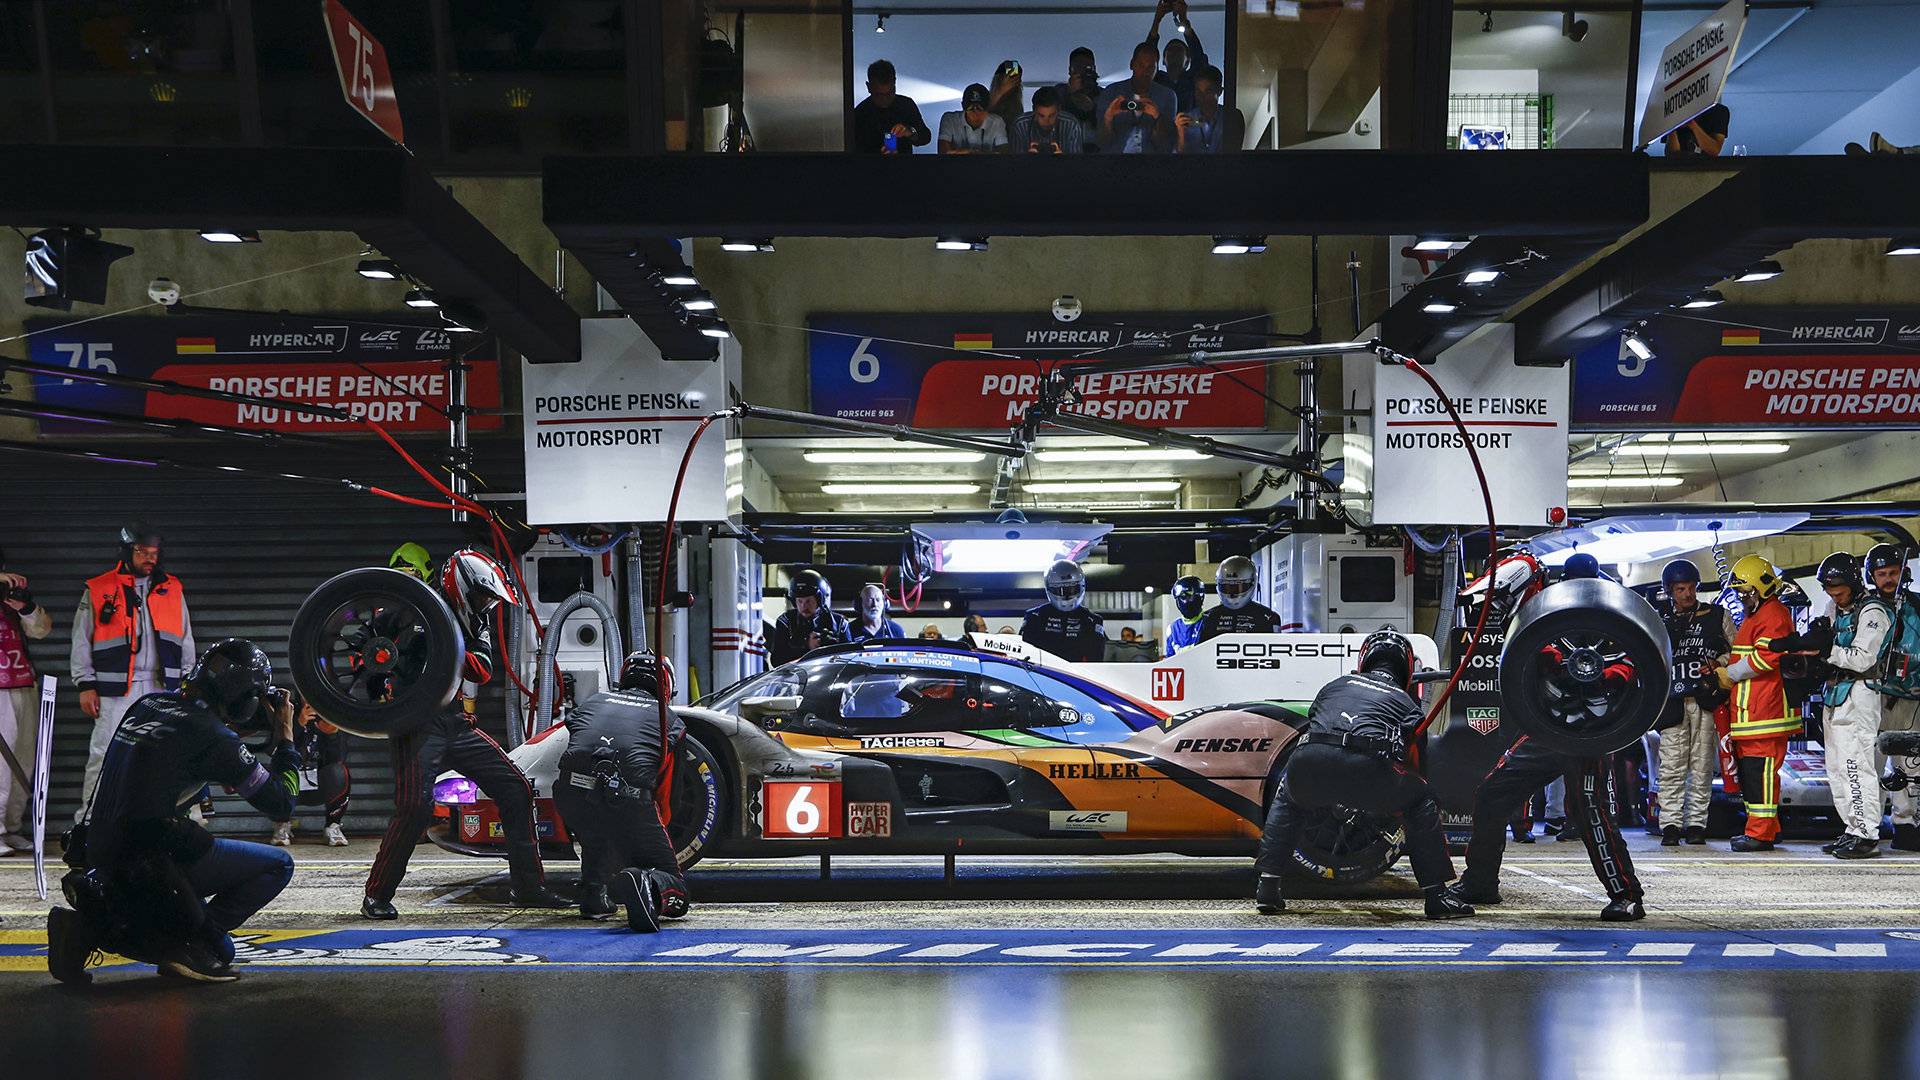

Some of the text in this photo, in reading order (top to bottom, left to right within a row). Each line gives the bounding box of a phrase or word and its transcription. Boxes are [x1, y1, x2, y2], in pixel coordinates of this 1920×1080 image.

[1664, 23, 1724, 80] PORSCHE PENSKE
[348, 22, 375, 112] 75
[1663, 73, 1710, 118] MOTORSPORT
[249, 333, 335, 347] HYPERCAR
[1025, 330, 1110, 344] HYPERCAR
[1791, 326, 1876, 340] HYPERCAR
[848, 337, 881, 383] 6
[1616, 333, 1647, 378] 5
[209, 374, 445, 399] PORSCHE PENSKE
[1108, 372, 1214, 395] PENSKE
[1744, 368, 1866, 390] PORSCHE
[535, 392, 701, 413] PORSCHE PENSKE
[1386, 397, 1547, 415] PORSCHE PENSKE
[1600, 404, 1657, 413] PORSCHE 963
[836, 408, 895, 418] PORSCHE 963
[537, 428, 663, 448] MOTORSPORT
[1386, 433, 1512, 449] MOTORSPORT
[984, 639, 1011, 652] Mobil
[1216, 643, 1362, 658] PORSCH
[1679, 638, 1704, 647] MEDIA
[907, 658, 953, 668] VANTHOOR
[937, 653, 980, 664] LOTTERER
[1216, 659, 1281, 670] 963
[1153, 671, 1183, 698] HY
[1458, 680, 1494, 692] Mobil
[1061, 709, 1077, 722] FIA
[1469, 709, 1497, 718] TAG
[120, 715, 179, 740] WEC
[1469, 719, 1499, 733] HEUER
[1174, 738, 1274, 753] PENSKE
[1049, 763, 1140, 779] HELLER
[1846, 758, 1864, 817] BROADCASTER
[701, 783, 716, 839] MICHELIN
[785, 785, 820, 834] 6
[850, 805, 888, 817] HYPER
[1065, 812, 1111, 823] WEC
[850, 816, 888, 835] CAR
[1583, 774, 1625, 894] PORSCHE
[652, 942, 1888, 959] MICHELIN
